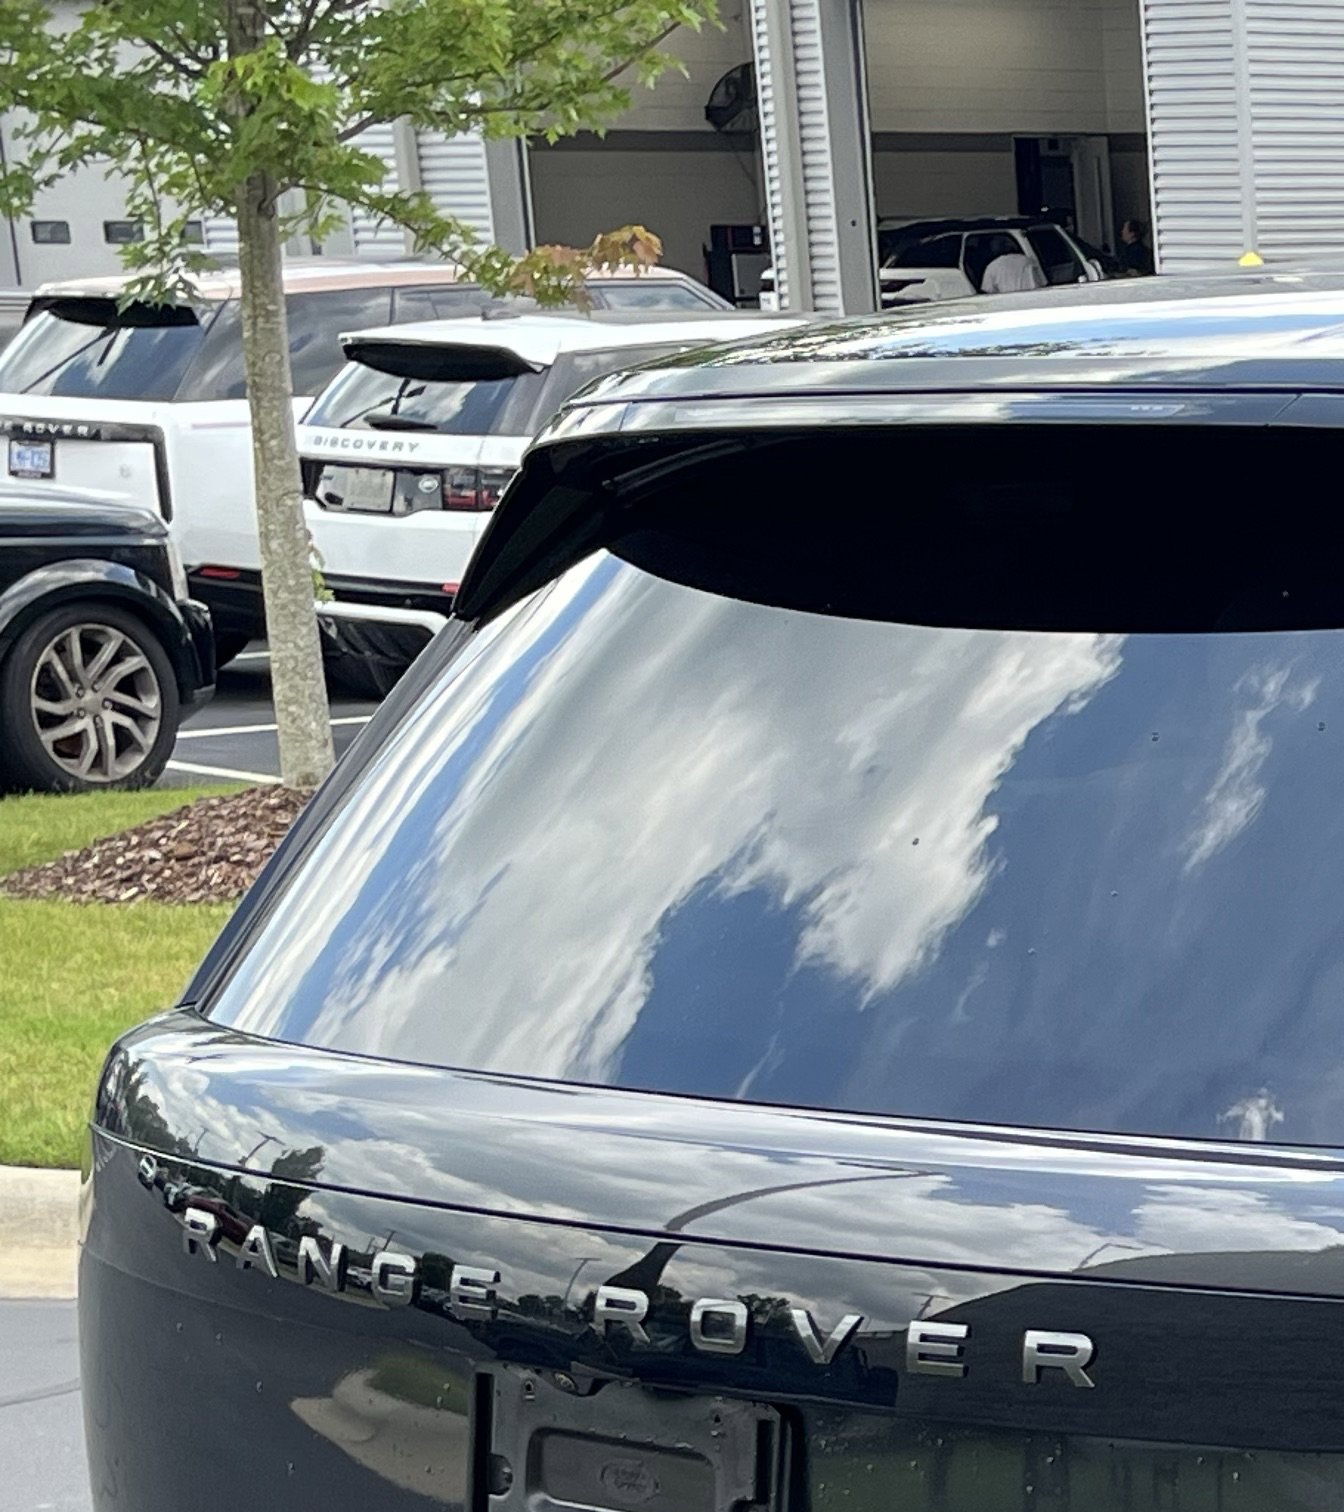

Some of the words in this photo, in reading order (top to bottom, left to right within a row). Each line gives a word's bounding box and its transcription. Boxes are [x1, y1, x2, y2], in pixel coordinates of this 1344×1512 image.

[23, 421, 88, 437] ROVER
[314, 436, 419, 453] DISCOVERY
[183, 1206, 500, 1321] RANGE
[595, 1285, 1096, 1388] ROVER
